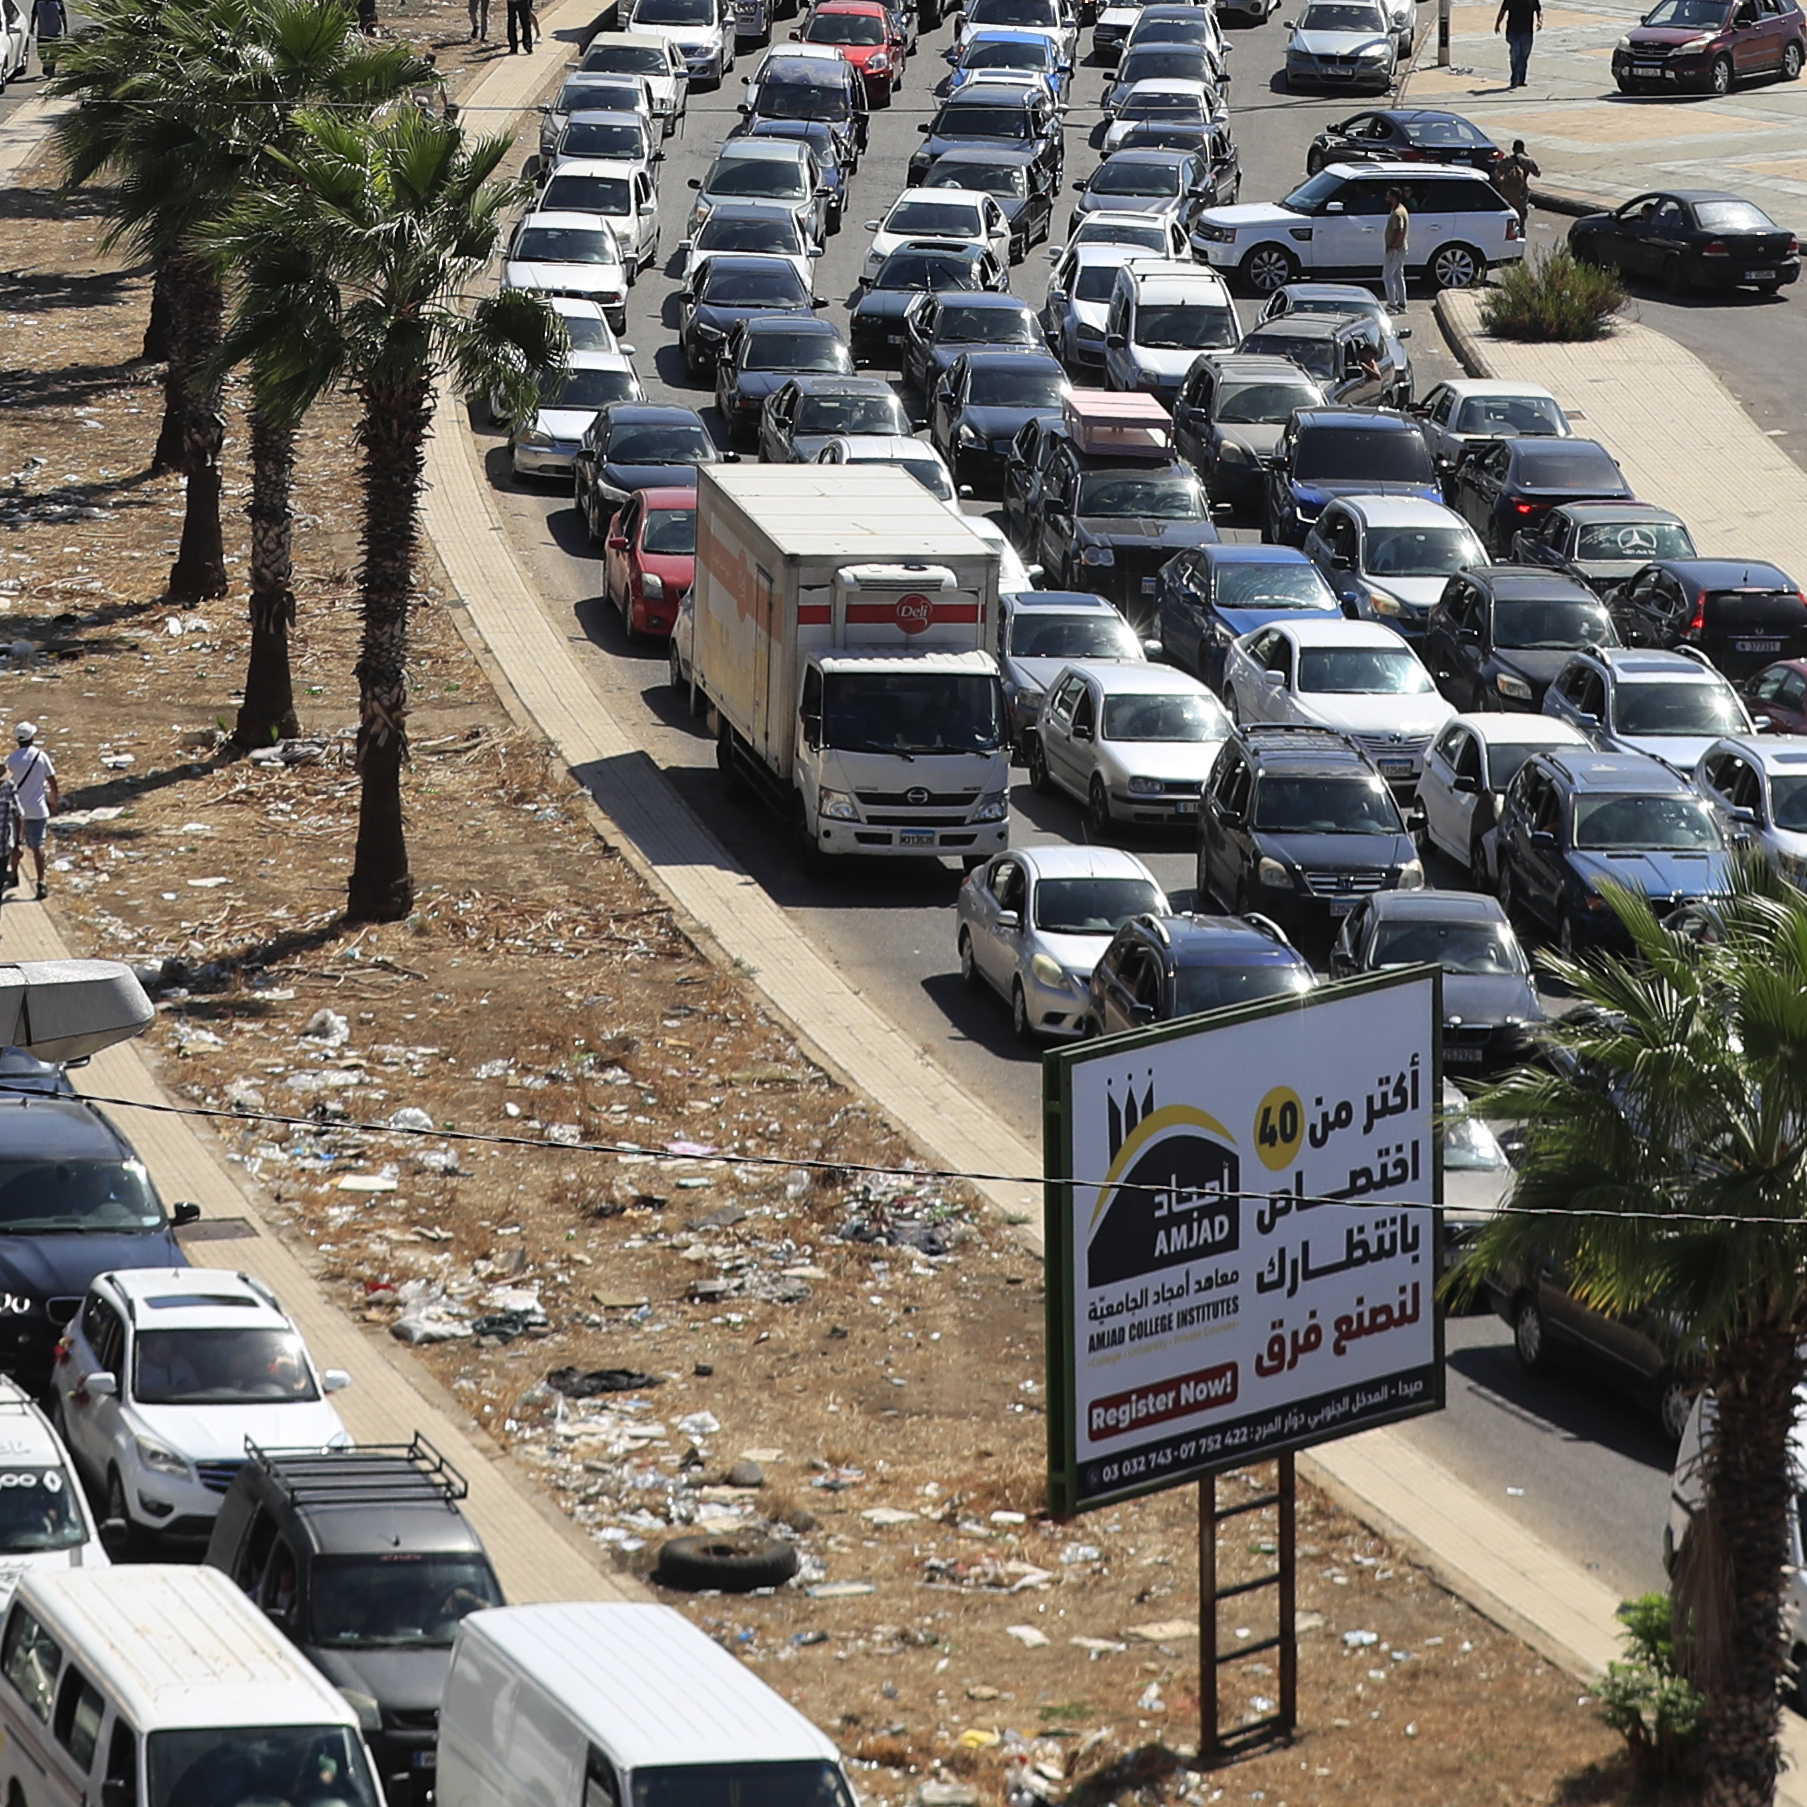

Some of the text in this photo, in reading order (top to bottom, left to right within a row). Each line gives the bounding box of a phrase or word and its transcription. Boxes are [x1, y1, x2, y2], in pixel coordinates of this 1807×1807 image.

[900, 605, 928, 617] Deli
[1258, 1053, 1420, 1149] أكتر من 40
[1256, 1140, 1420, 1235] اختصاص
[1194, 1266, 1240, 1294] معاهد
[1256, 1213, 1420, 1298] بانتظارك
[1154, 1270, 1191, 1306] أمجاد
[1088, 1294, 1240, 1353] AMJAD COLLEGE INSTITUTES
[1254, 1281, 1421, 1377] لنصنع فرق
[1090, 1373, 1233, 1432] Register Now!
[1307, 1396, 1350, 1431] الجنوبي
[1351, 1385, 1389, 1414] المدخل
[1398, 1378, 1424, 1398] صيدا
[1102, 1464, 1120, 1483] 03
[1122, 1455, 1147, 1478] 032
[1199, 1433, 1223, 1454] 752
[1224, 1426, 1249, 1447] 422
